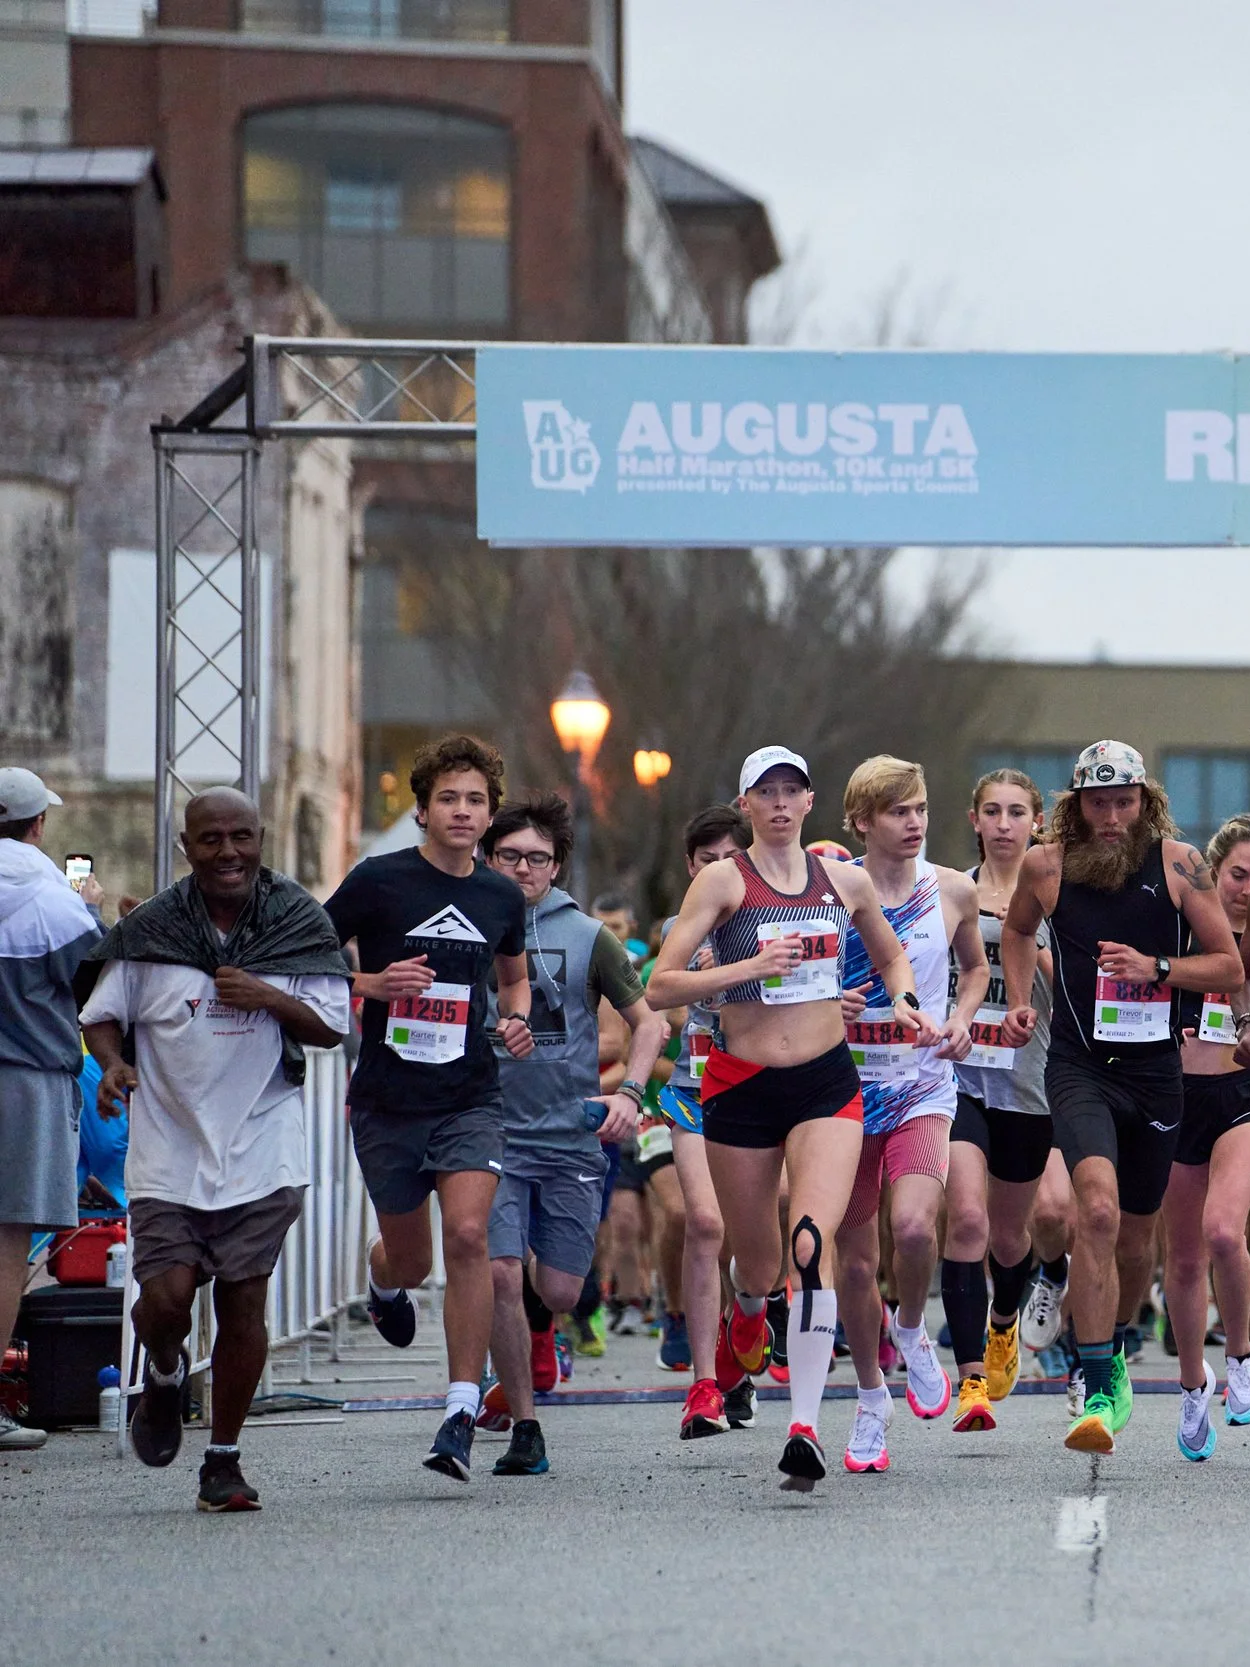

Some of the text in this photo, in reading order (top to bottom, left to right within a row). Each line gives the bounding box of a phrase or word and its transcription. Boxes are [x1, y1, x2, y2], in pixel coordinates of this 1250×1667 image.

[616, 400, 979, 456] AUGUSTA
[617, 455, 979, 479] Half Marathon, 10K and 5K
[617, 478, 980, 495] presented by The Augusta Sports Council
[403, 938, 485, 954] NIKE TRAIL
[801, 935, 826, 959] 94
[1116, 980, 1154, 1000] 884
[403, 995, 457, 1023] 1295
[1119, 1009, 1142, 1017] Trevor
[410, 1030, 436, 1039] Karter
[534, 1037, 566, 1046] MOUR
[854, 1022, 905, 1043] 1184
[970, 1022, 1003, 1045] 041
[866, 1052, 888, 1060] Adam
